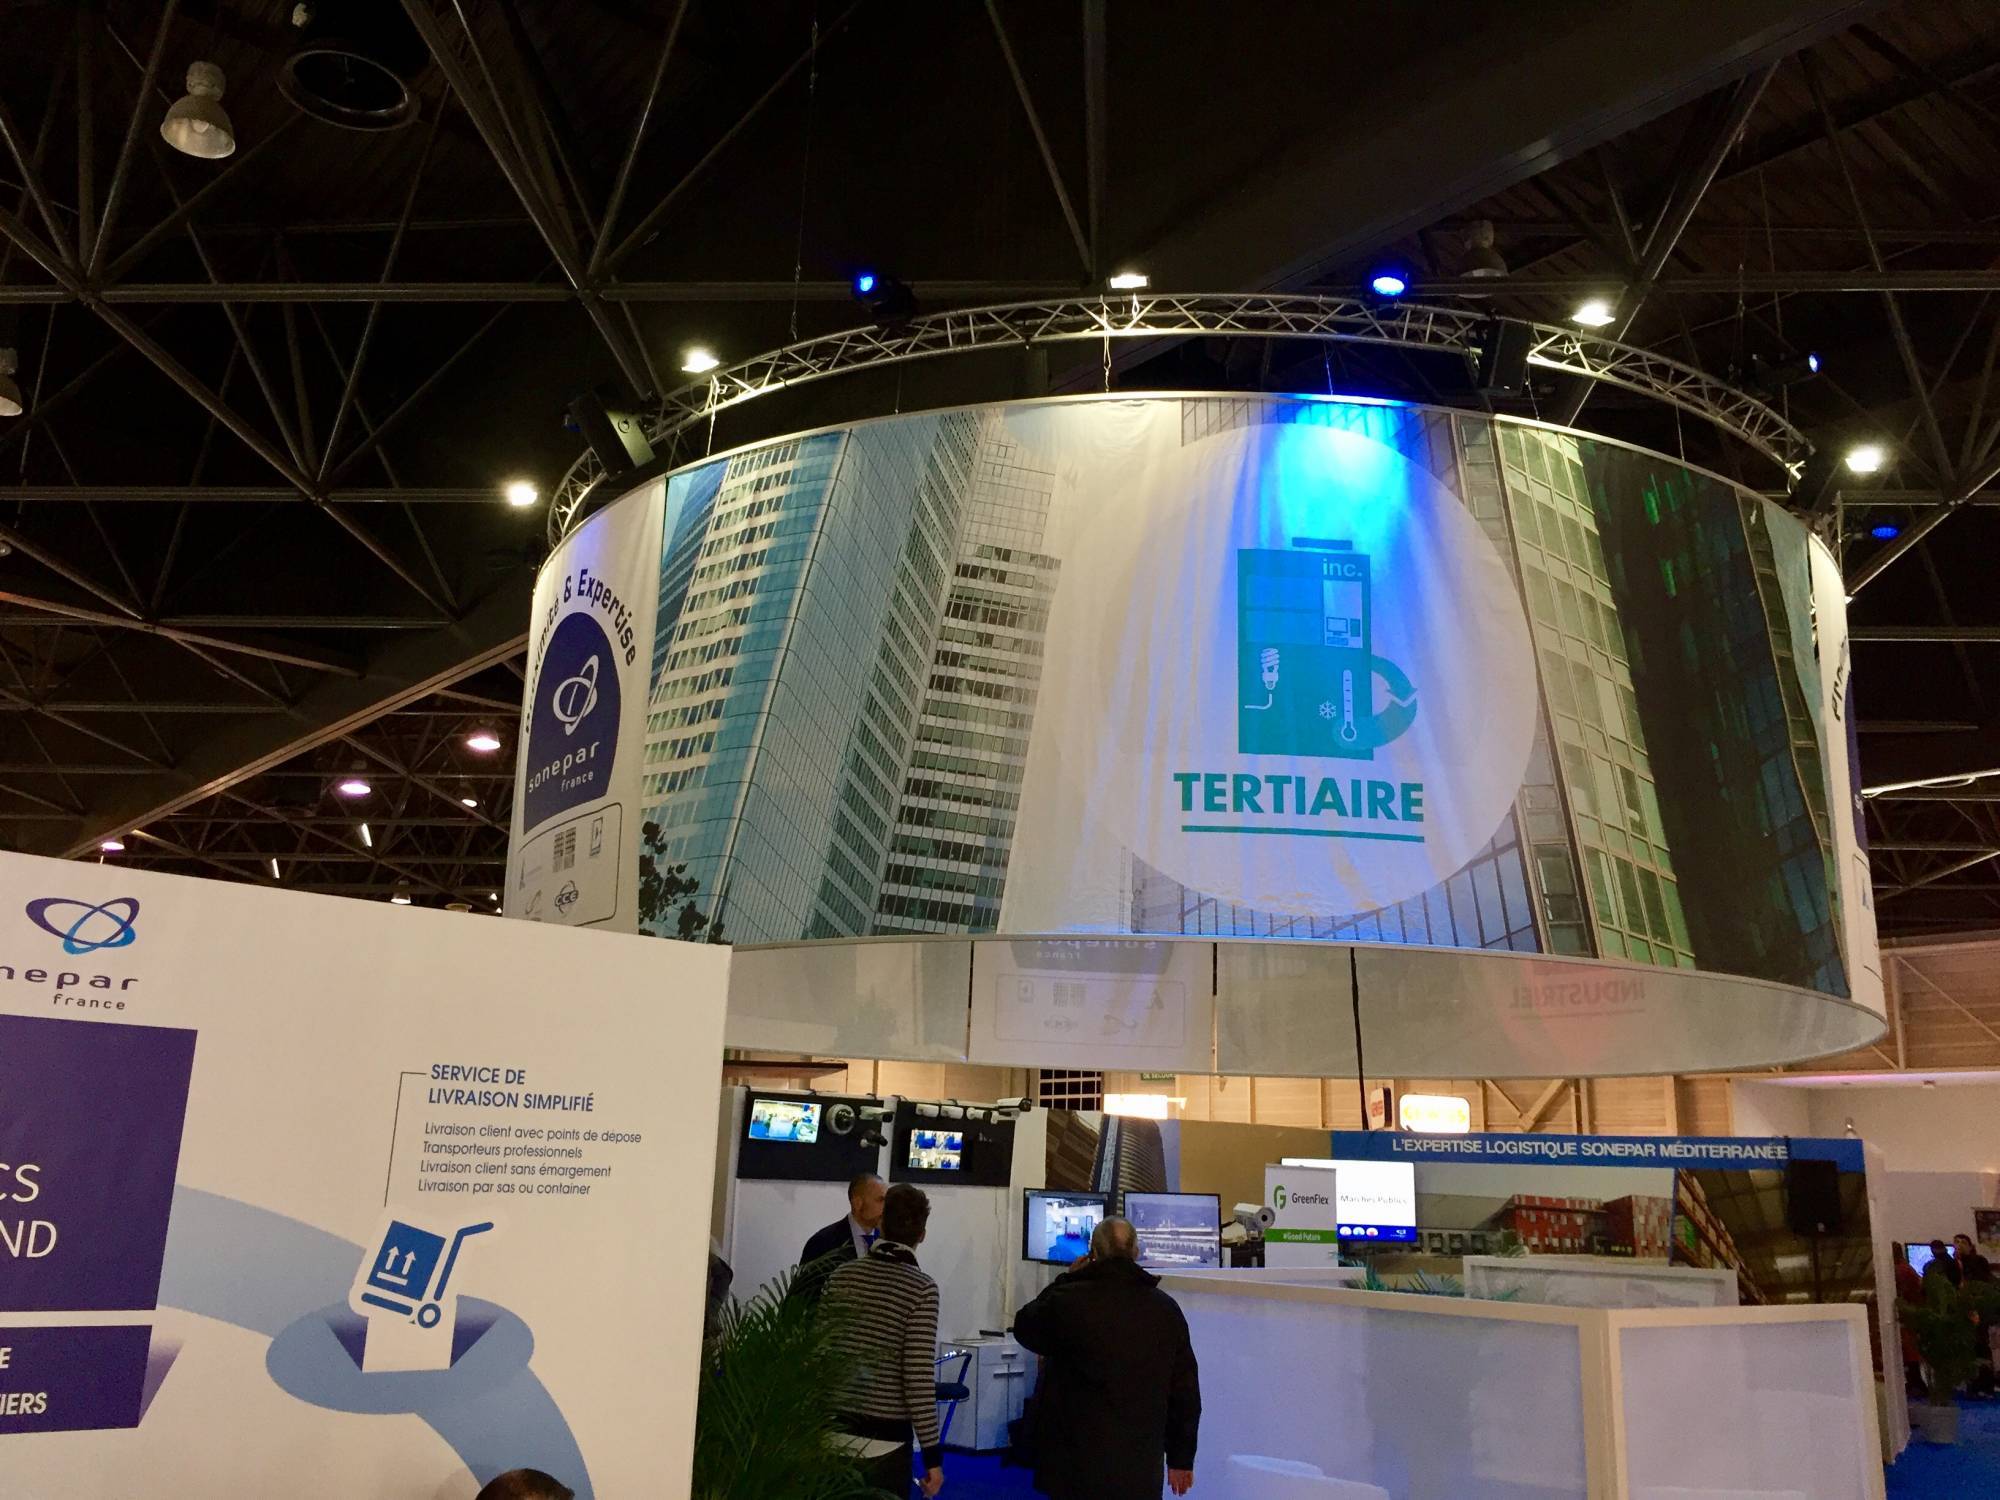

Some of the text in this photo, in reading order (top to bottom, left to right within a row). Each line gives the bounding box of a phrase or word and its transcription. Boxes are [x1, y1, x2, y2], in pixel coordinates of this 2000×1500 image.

[1322, 557, 1363, 577] inc.
[563, 575, 572, 604] &
[577, 568, 637, 667] Expertise
[528, 741, 600, 793] sonepar
[561, 770, 594, 792] france
[1173, 772, 1425, 822] TERTIAIRE
[53, 993, 126, 1011] france
[431, 1064, 526, 1085] SERVICE DE
[428, 1088, 594, 1112] LIVRAISON SIMPLIFIÉ
[425, 1122, 476, 1137] Livraison
[479, 1125, 511, 1138] client
[514, 1129, 544, 1139] avec
[547, 1128, 580, 1142] points
[583, 1130, 598, 1141] de
[423, 1140, 583, 1159] Transporteurs professionnels
[1393, 1139, 1482, 1153] L'EXPERTISE
[1487, 1140, 1577, 1158] LOGISTIQUE
[1581, 1142, 1656, 1157] SONEPAR
[420, 1160, 611, 1179] Livraison client sans émargement
[418, 1179, 590, 1195] Livraison par sas ou container
[1292, 1192, 1329, 1206] GreenFlex
